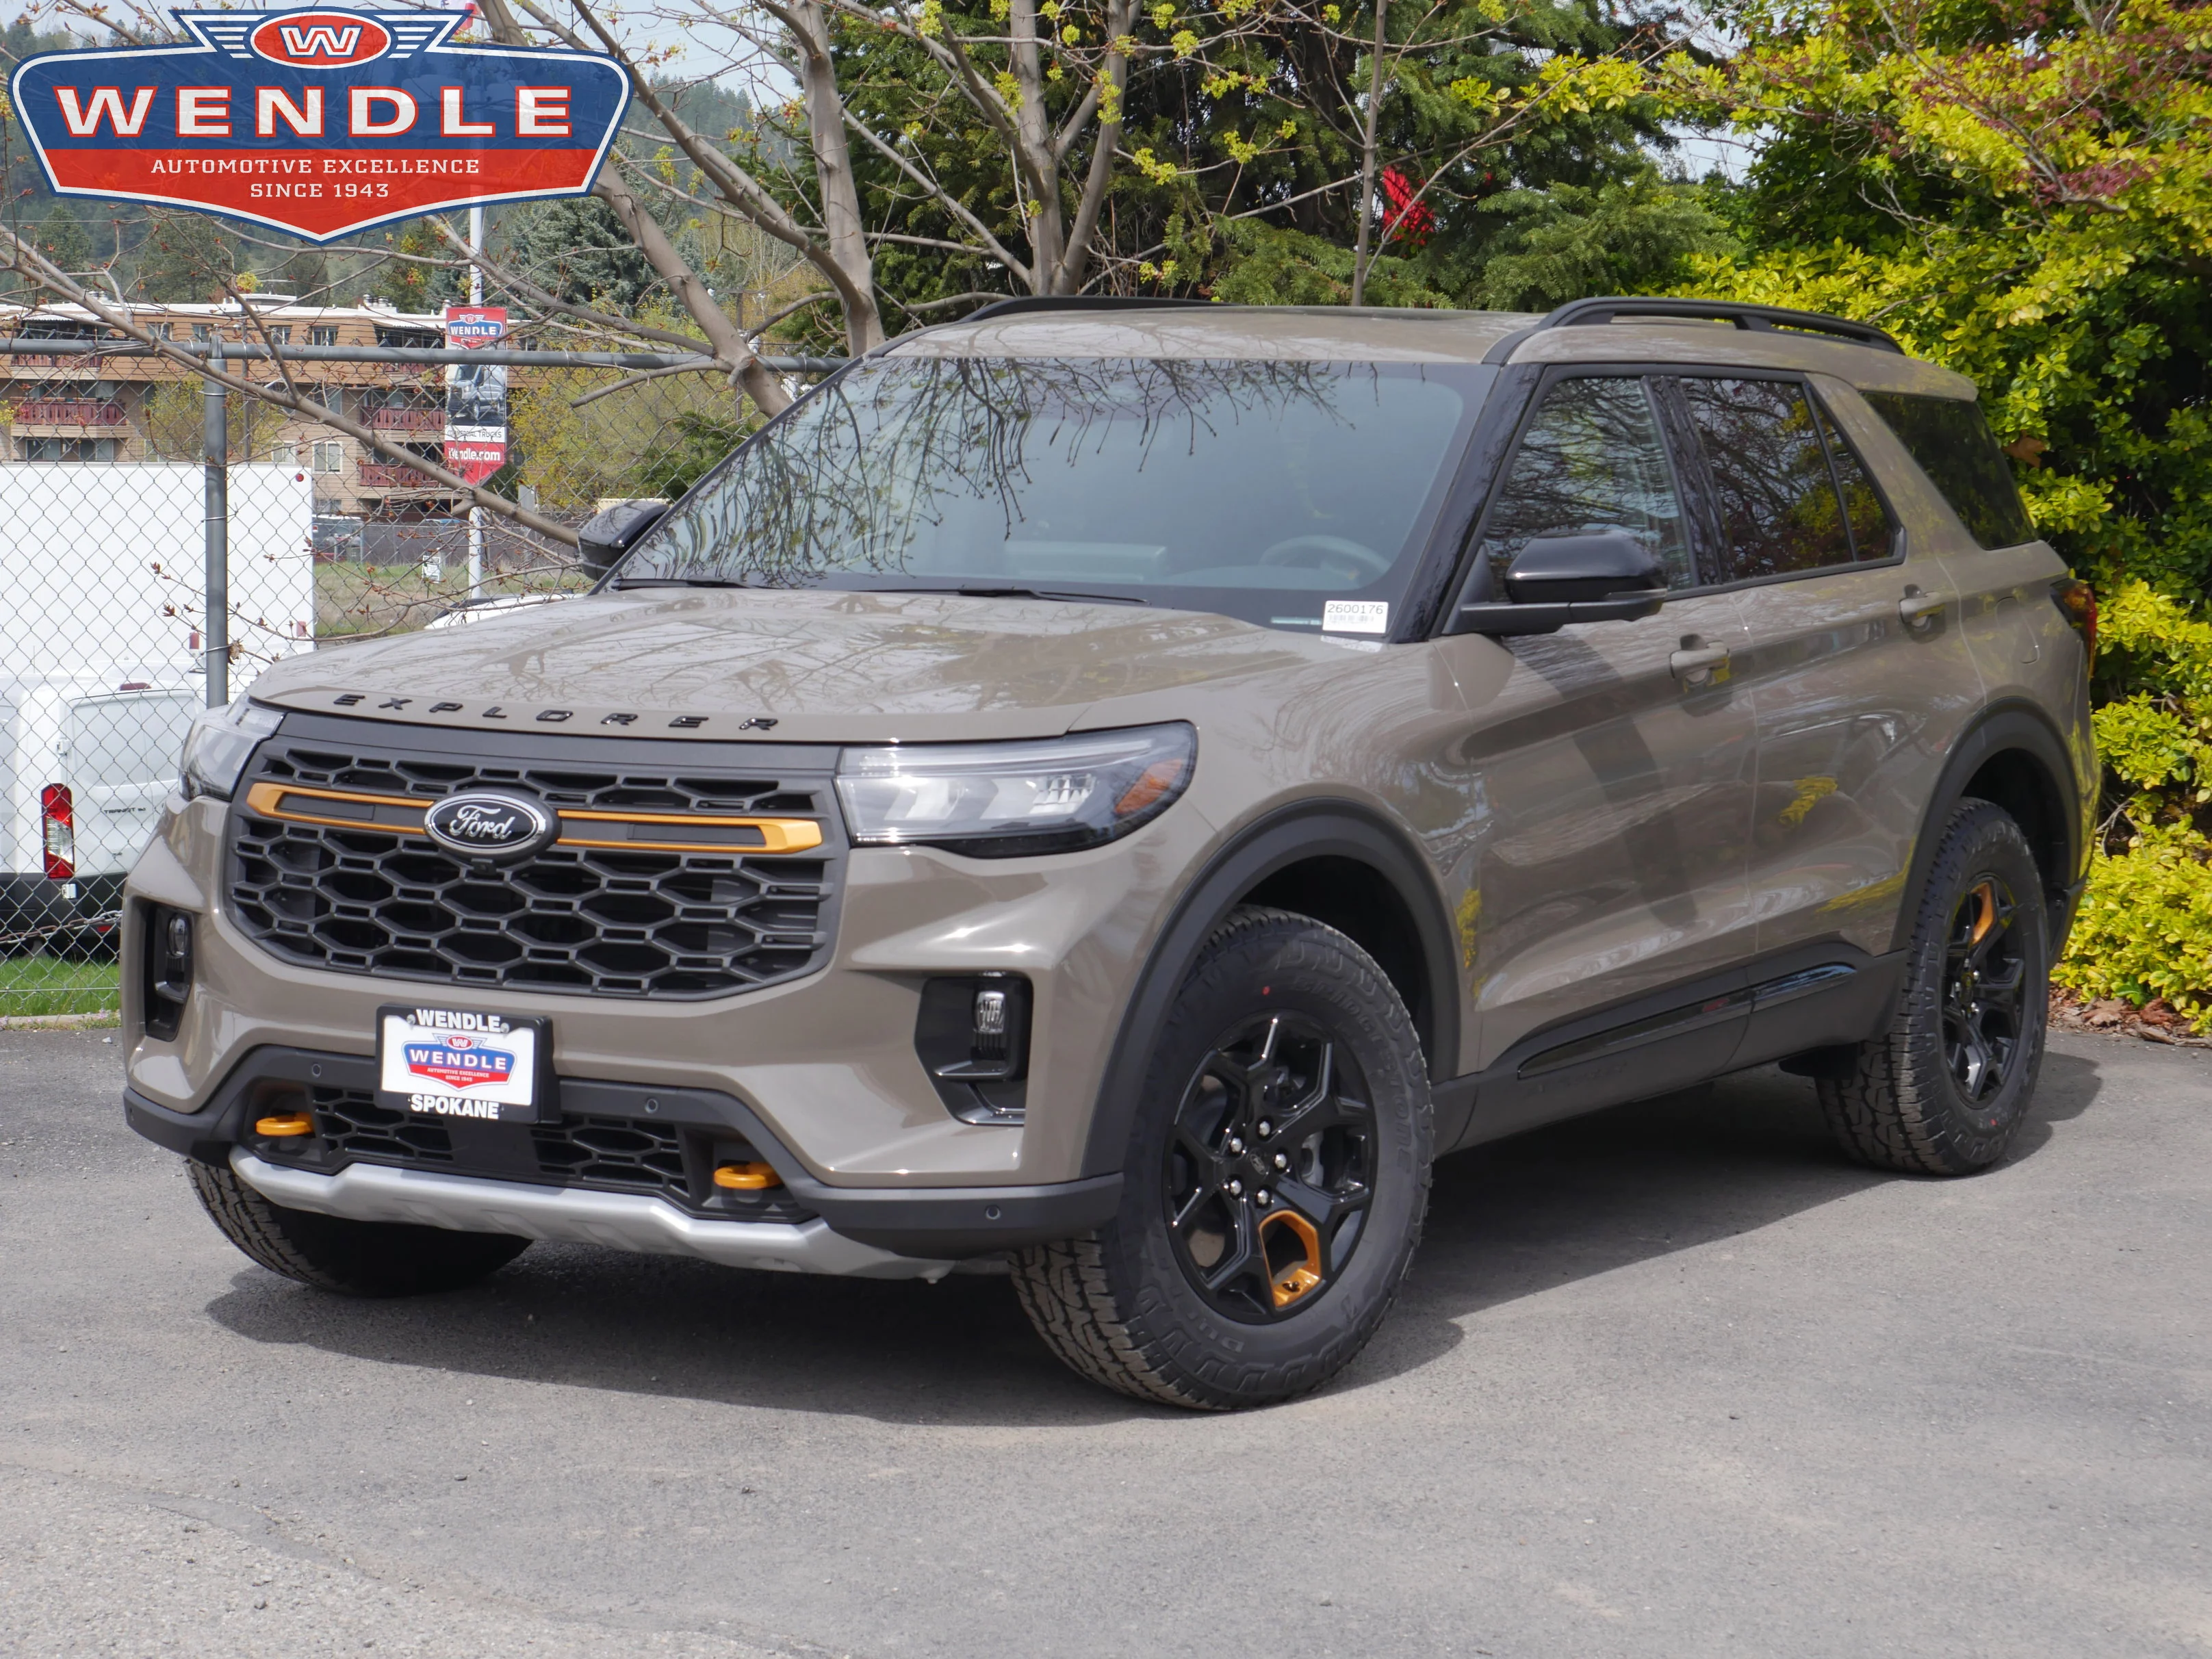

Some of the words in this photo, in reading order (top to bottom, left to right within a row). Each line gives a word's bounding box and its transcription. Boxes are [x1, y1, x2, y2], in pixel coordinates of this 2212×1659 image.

[450, 326, 497, 335] WENDLE
[1327, 604, 1384, 615] 2600176
[333, 693, 778, 731] EXPLORER
[448, 804, 515, 841] Ford
[416, 1009, 501, 1033] WENDLE
[409, 1049, 506, 1070] WENDLE
[411, 1094, 499, 1119] SPOKANE
